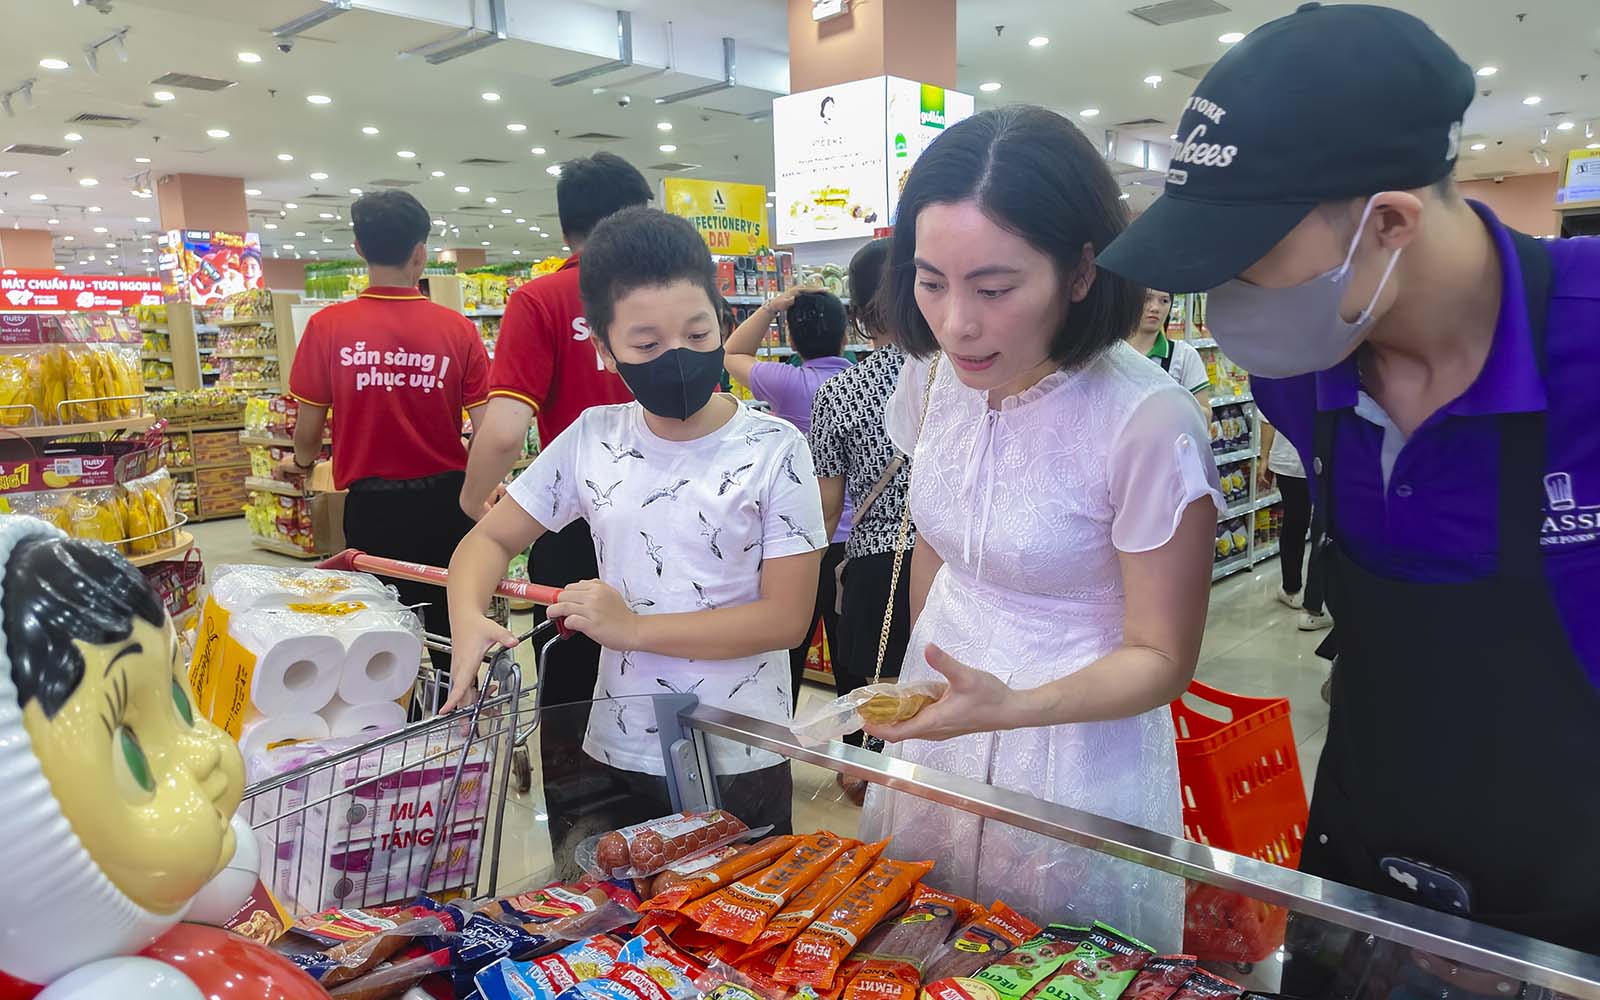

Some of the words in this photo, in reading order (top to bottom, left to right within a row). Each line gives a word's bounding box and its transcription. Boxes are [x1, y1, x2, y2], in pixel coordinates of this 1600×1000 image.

[1191, 96, 1227, 125] YORK
[709, 231, 731, 248] DAY
[120, 281, 152, 291] NGON
[340, 341, 380, 366] Sẵn
[384, 346, 435, 372] sàng
[356, 366, 406, 392] phục
[83, 458, 107, 470] nutty
[987, 915, 1024, 939] РЕМИТ
[858, 980, 902, 996] РЕМИТ
[980, 971, 1018, 990] ПЕСТО
